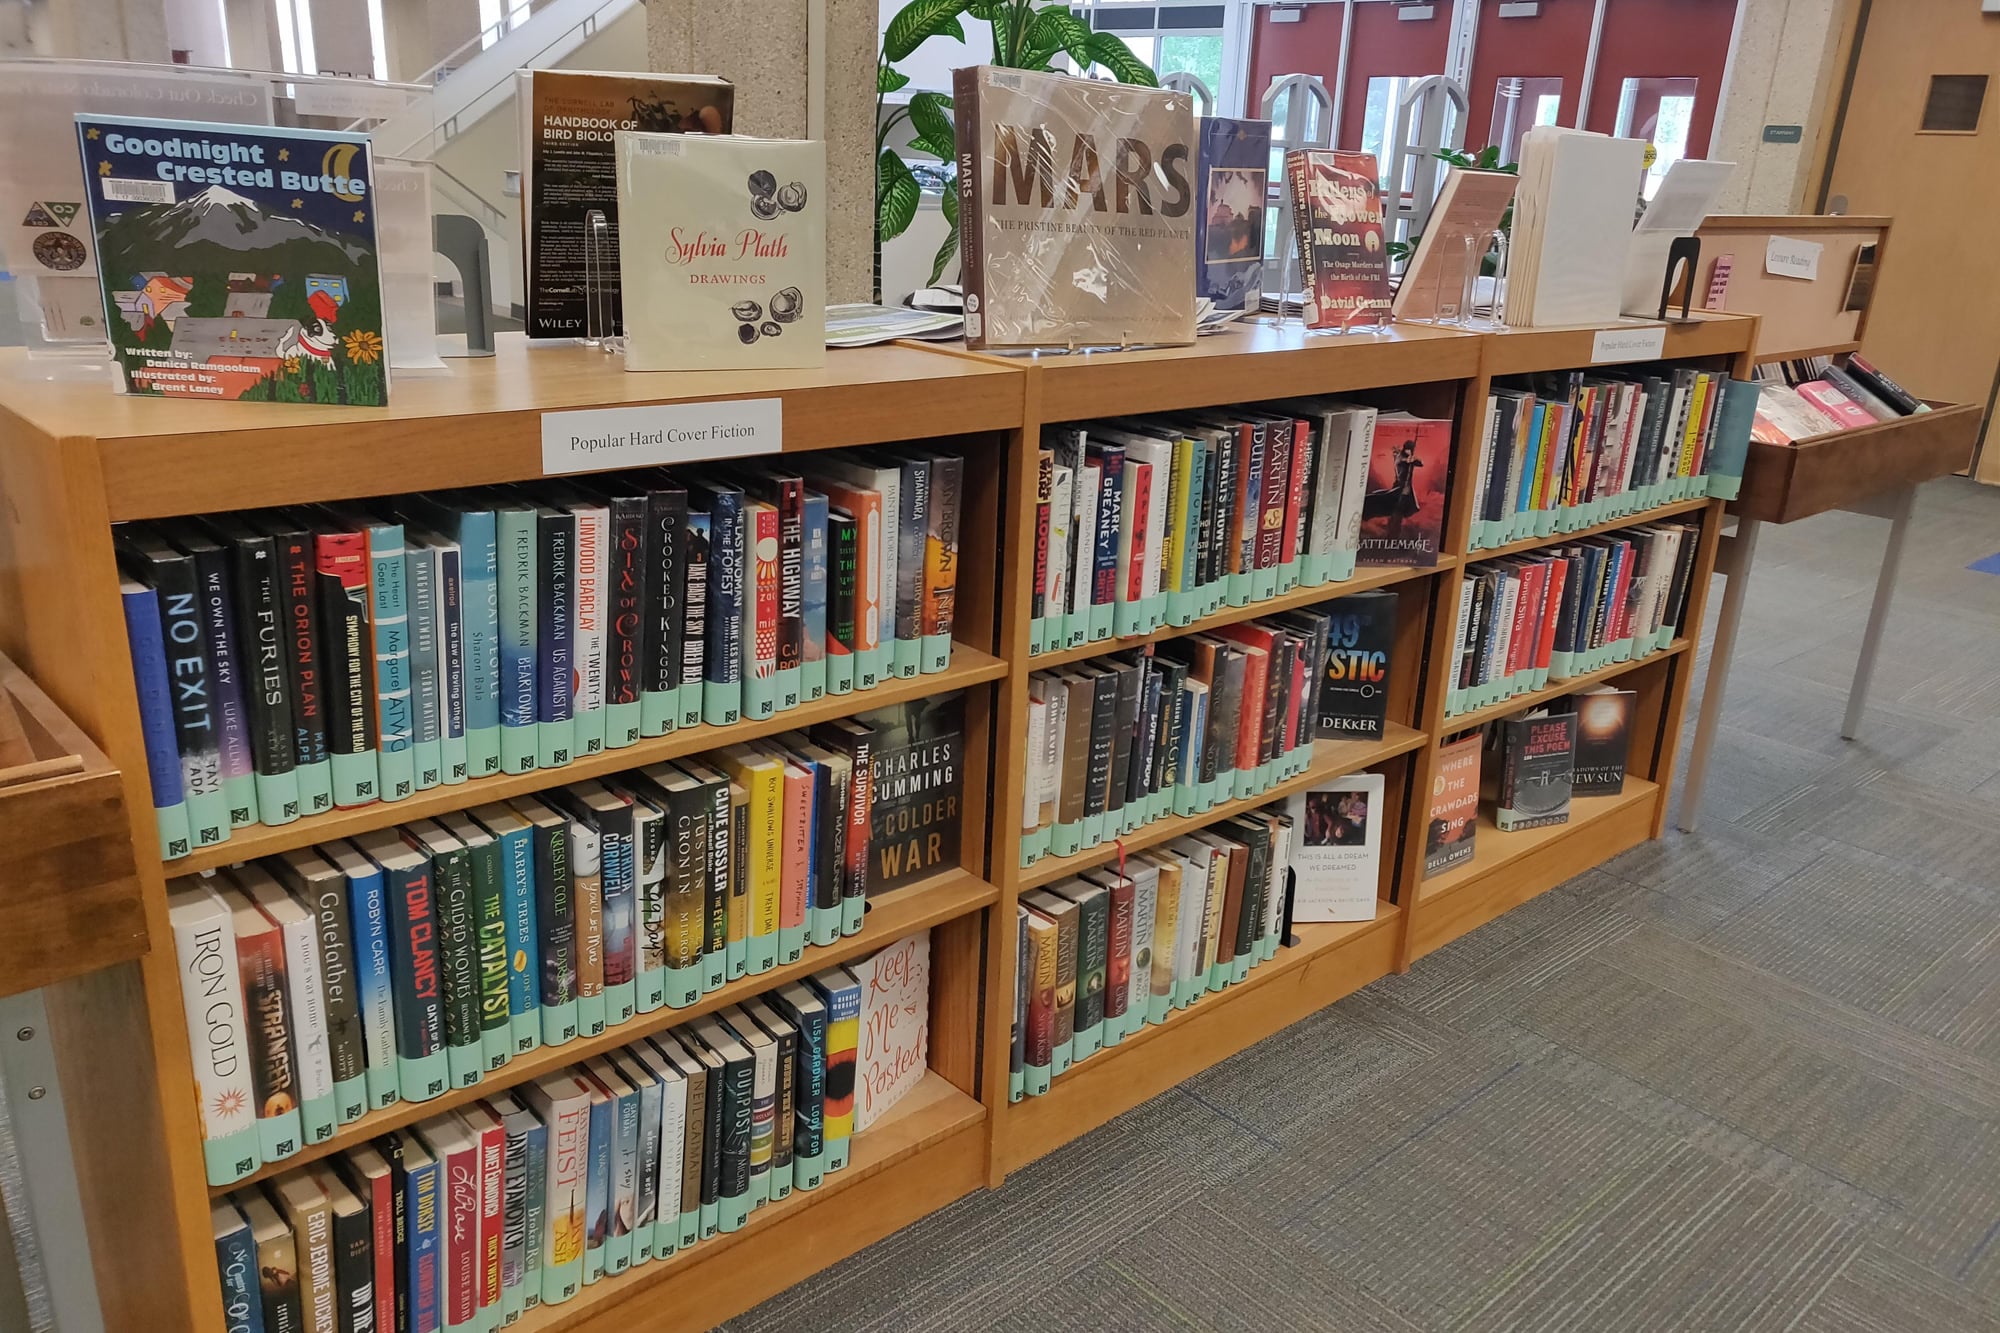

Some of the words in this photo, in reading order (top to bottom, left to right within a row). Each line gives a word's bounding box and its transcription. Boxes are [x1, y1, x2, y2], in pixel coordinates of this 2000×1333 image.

[544, 115, 618, 129] HANDBOOK
[621, 120, 637, 130] OF
[544, 129, 572, 139] BIRD
[576, 131, 613, 142] BIOLO
[105, 134, 264, 165] Goodnight
[156, 162, 273, 188] Crested
[281, 171, 366, 195] Butte
[962, 154, 972, 198] MARS
[992, 124, 1190, 218] MARS
[665, 227, 726, 266] Sylvia
[732, 229, 788, 261] Plath
[1018, 221, 1063, 233] PRISTINE
[1105, 226, 1116, 235] OF
[1119, 227, 1136, 237] THE
[1139, 229, 1156, 238] RED
[1158, 229, 1189, 240] PLANET
[1314, 228, 1360, 246] Moon
[690, 274, 766, 284] DRAWINGS
[539, 319, 582, 328] WILEY
[1321, 296, 1353, 309] David
[1357, 296, 1391, 309] Grann
[126, 347, 169, 358] Written
[172, 348, 193, 360] by:
[146, 359, 186, 370] Danica
[190, 361, 261, 374] Ramgoolam
[131, 371, 190, 382] Illustrated
[194, 373, 216, 383] by:
[571, 435, 625, 452] Popular
[630, 430, 663, 446] Hard
[667, 428, 707, 443] Cover
[712, 424, 755, 439] Fiction
[1250, 429, 1265, 481] DUNE
[1267, 428, 1284, 505] MARTIN
[912, 470, 925, 521] SHANNARA
[1099, 477, 1113, 549] GREANEY
[1111, 490, 1122, 534] MARK
[723, 518, 732, 529] IN
[723, 530, 731, 546] THE
[783, 514, 801, 544] THE
[1215, 507, 1225, 550] HOWL
[486, 542, 495, 572] THE
[517, 529, 529, 582] FREDRIK
[552, 531, 565, 578] FREDRIK
[579, 516, 595, 574] LINWOOD
[656, 516, 675, 610] CROOKED
[1036, 505, 1049, 594] BLOODLINE
[208, 572, 220, 592] WE
[260, 576, 270, 604] THE
[290, 562, 306, 597] THE
[721, 549, 733, 596] FOREST
[782, 550, 801, 619] HIGHWAY
[1521, 571, 1533, 605] Daniel
[166, 593, 199, 643] NO
[210, 596, 223, 627] OWN
[487, 583, 498, 625] BOAT
[518, 586, 530, 647] BACKMAN
[553, 582, 565, 640] BACKMAN
[579, 578, 596, 632] BARCLAY
[1515, 606, 1526, 631] Silva
[214, 632, 227, 657] THE
[294, 604, 311, 664] ORION
[346, 615, 359, 657] SYMPHONY
[591, 636, 599, 650] THE
[659, 616, 670, 691] KINGDO
[218, 661, 231, 684] SKY
[257, 610, 282, 707] FURIES
[349, 659, 360, 673] FOR
[452, 658, 459, 668] of
[489, 632, 499, 699] PEOPLE
[175, 655, 211, 733] EXIT
[299, 669, 317, 718] PLAN
[349, 674, 361, 688] THE
[350, 689, 362, 706] CITY
[451, 669, 460, 699] loving
[517, 656, 532, 725] BEARTOWN
[351, 707, 363, 719] OF
[352, 719, 364, 733] THE
[453, 701, 461, 730] others
[1148, 714, 1158, 741] LOVE
[1322, 717, 1377, 731] DEKKER
[1531, 722, 1567, 735] PLEASE
[353, 734, 365, 752] DEAD
[857, 743, 870, 767] THE
[1524, 744, 1545, 754] THIS
[1546, 741, 1571, 752] POEM
[1531, 732, 1566, 744] EXCUSE
[873, 743, 951, 779] CHARLES
[1442, 756, 1473, 772] WHERE
[1597, 771, 1621, 782] SUN
[715, 787, 729, 824] CLIVE
[853, 768, 868, 826] SURVIVOR
[871, 766, 954, 804] CUMMING
[1430, 792, 1478, 817] CRAWDADS
[1448, 779, 1464, 791] THE
[885, 795, 957, 836] COLDER
[1441, 817, 1464, 834] SING
[514, 838, 529, 897] HARRY'S
[551, 829, 565, 877] KRESLEY
[602, 832, 621, 901] CORNWELL
[621, 833, 633, 892] PATRICIA
[678, 815, 691, 895] CRONIN
[693, 814, 705, 890] JUSTIN
[714, 826, 729, 893] CUSSLER
[880, 832, 942, 880] WAR
[1428, 854, 1447, 869] DELIA
[1449, 847, 1472, 860] OWENS
[405, 875, 430, 921] TOM
[453, 873, 461, 888] THE
[553, 880, 568, 921] COLE
[367, 889, 381, 938] ROBYN
[450, 889, 466, 945] GILDED
[483, 893, 500, 921] THE
[517, 901, 530, 945] TREES
[1135, 888, 1148, 946] MARTIN
[319, 892, 347, 1004] Gatefather
[1086, 911, 1098, 971] MARTIN
[1115, 901, 1130, 958] MARTIN
[188, 927, 228, 997] IRON
[370, 939, 384, 977] CARR
[409, 923, 437, 1000] CLANCY
[453, 946, 471, 1000] WOLVES
[479, 921, 510, 1021] CATALYST
[869, 941, 916, 1008] Keep
[1039, 935, 1051, 986] MARTIN
[1057, 926, 1070, 985] MARTIN
[426, 1003, 437, 1027] OATH
[812, 1018, 822, 1044] LISA
[864, 1003, 899, 1062] Me
[205, 1001, 238, 1078] GOLD
[812, 1050, 822, 1097] GARDNER
[863, 1023, 926, 1112] Posted
[735, 1068, 752, 1137] OUTPOST
[485, 1143, 501, 1172] JANET
[505, 1131, 527, 1173] JANET
[556, 1111, 579, 1189] FEIST
[484, 1169, 502, 1218] EVANOVICH
[504, 1173, 526, 1251] EVANOVICH
